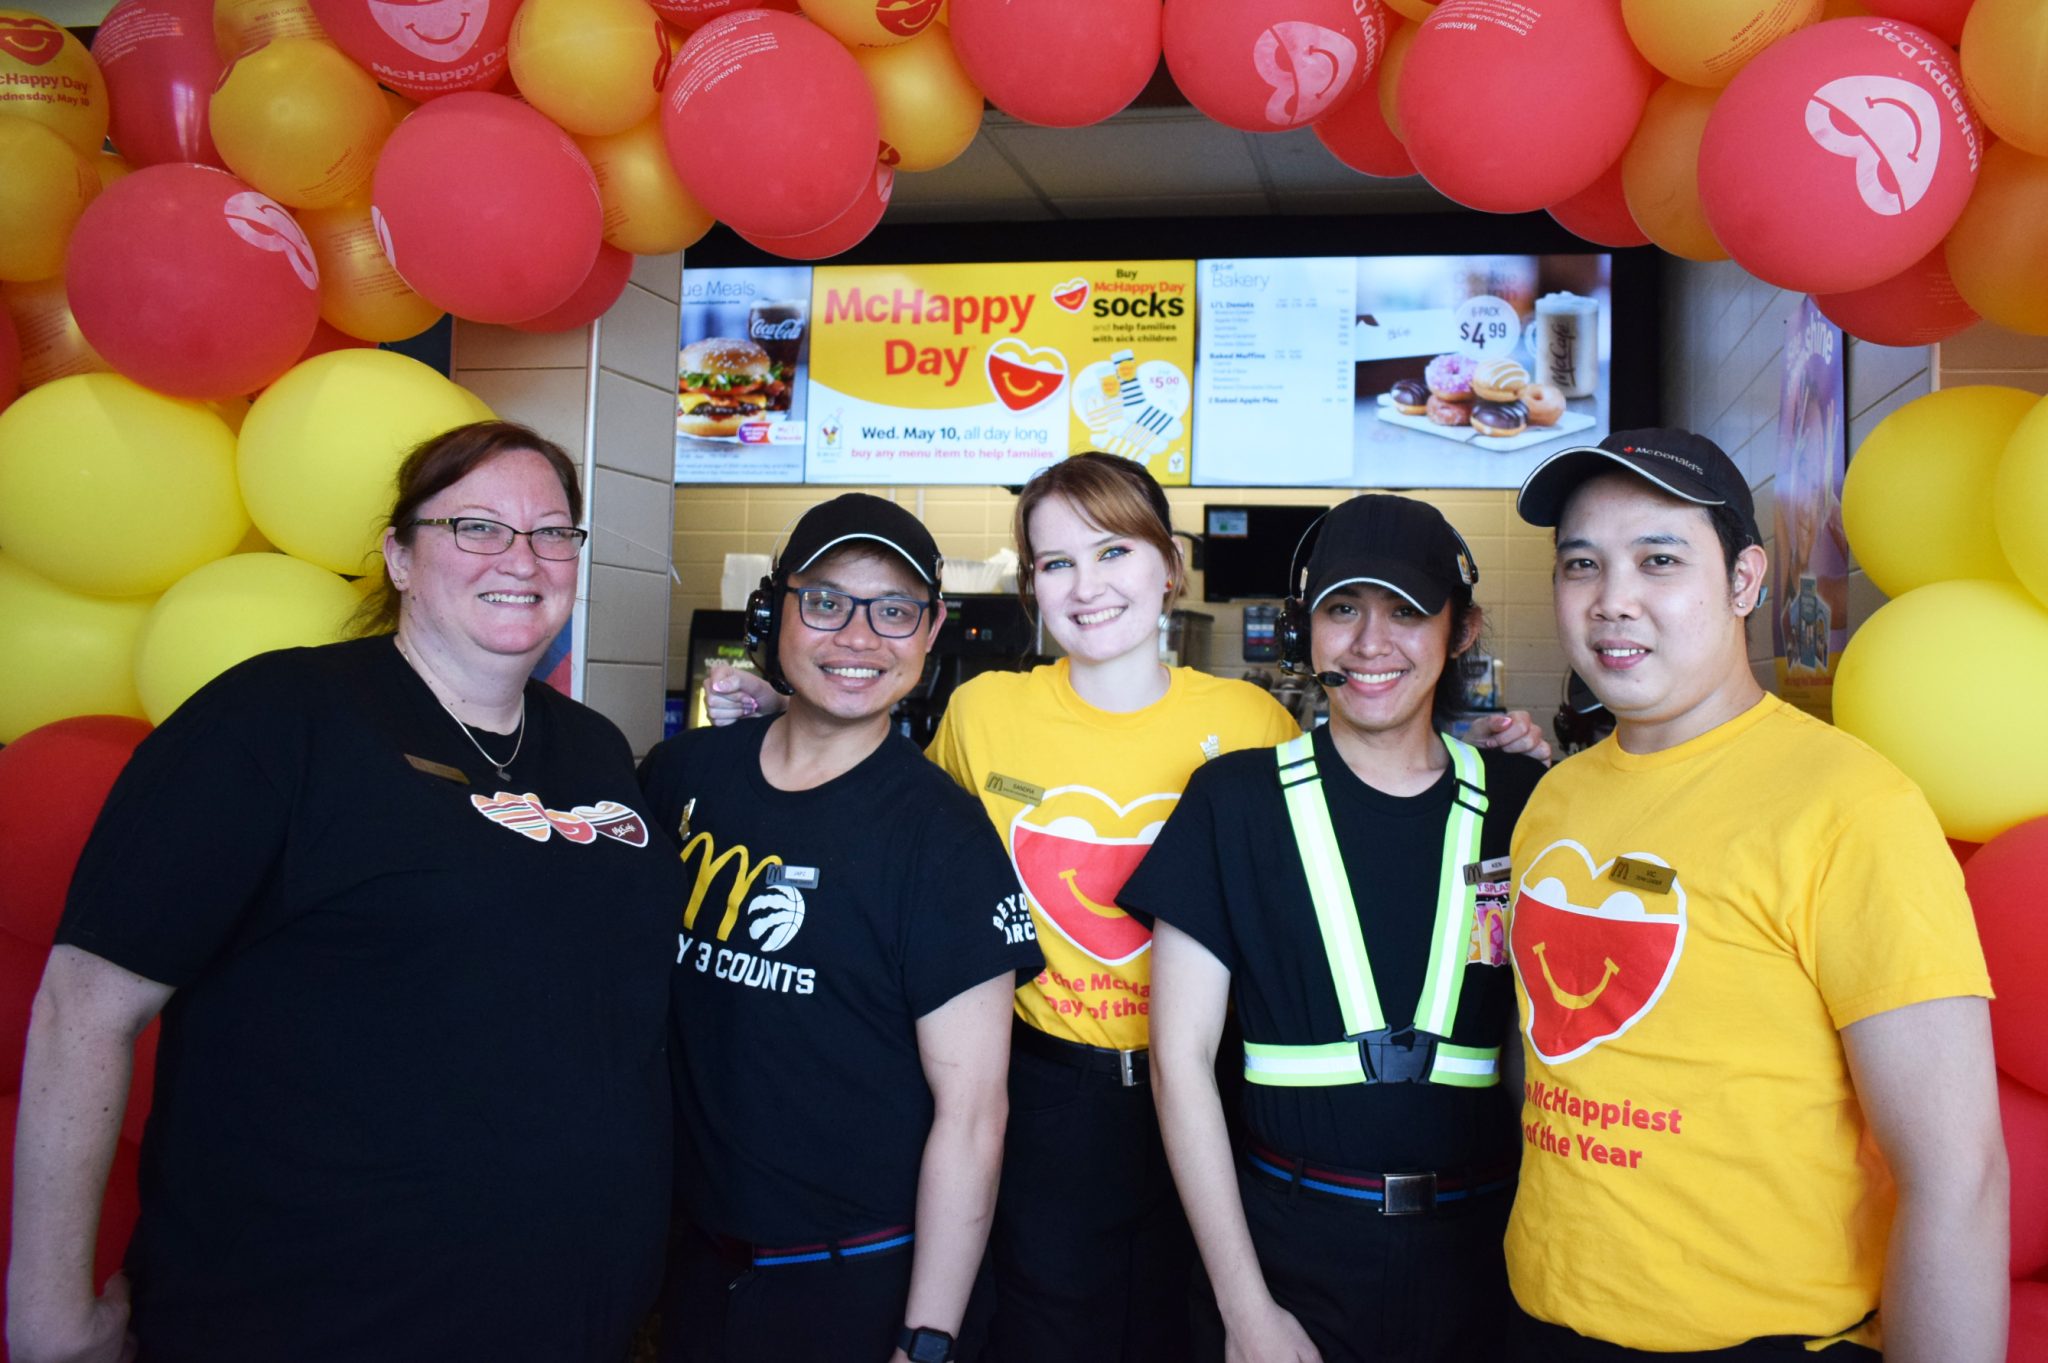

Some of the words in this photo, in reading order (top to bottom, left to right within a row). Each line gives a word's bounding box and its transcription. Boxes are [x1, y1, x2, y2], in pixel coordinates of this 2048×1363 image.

[1494, 18, 1527, 36] CHOKING
[1868, 26, 1918, 59] Day
[1905, 31, 1938, 55] May
[372, 61, 479, 82] McHappy
[482, 46, 507, 67] Da
[0, 73, 58, 89] cHappy
[62, 76, 88, 96] Day
[0, 92, 56, 104] dnesday,
[1917, 59, 1978, 172] McHappy
[1116, 269, 1138, 280] Buy
[1212, 272, 1270, 292] Bakery
[682, 283, 702, 297] ue
[706, 281, 756, 297] Meals
[1094, 281, 1156, 296] McHappy
[1159, 281, 1184, 295] Day
[823, 287, 1036, 335] McHappy
[1093, 292, 1184, 318] socks
[1092, 335, 1113, 343] with
[1116, 335, 1135, 343] sick
[1137, 334, 1177, 343] children
[1113, 322, 1134, 333] help
[1136, 321, 1176, 331] families
[885, 339, 970, 387] Day
[862, 427, 899, 441] Wed.
[904, 427, 935, 444] May
[940, 428, 960, 442] 10,
[964, 427, 980, 440] all
[984, 427, 1010, 443] day
[1015, 426, 1048, 443] long
[851, 449, 871, 460] buy
[875, 450, 894, 460] any
[899, 450, 931, 459] menu
[934, 448, 960, 459] item
[964, 449, 975, 459] to
[979, 449, 1004, 460] help
[1007, 448, 1053, 459] families
[1635, 446, 1704, 476] McDonald's
[1484, 881, 1512, 893] SPLAS
[993, 893, 1028, 932] BEYO
[1004, 921, 1036, 945] ARC
[676, 933, 694, 964] Y
[695, 941, 713, 974] 3
[714, 947, 817, 995] COUNTS
[1051, 971, 1086, 993] the
[1091, 973, 1151, 999] McHa
[1112, 996, 1150, 1018] the
[1533, 1080, 1683, 1135] McHappiest
[1525, 1121, 1541, 1147] of
[1540, 1126, 1571, 1158] the
[1577, 1133, 1643, 1169] Year
